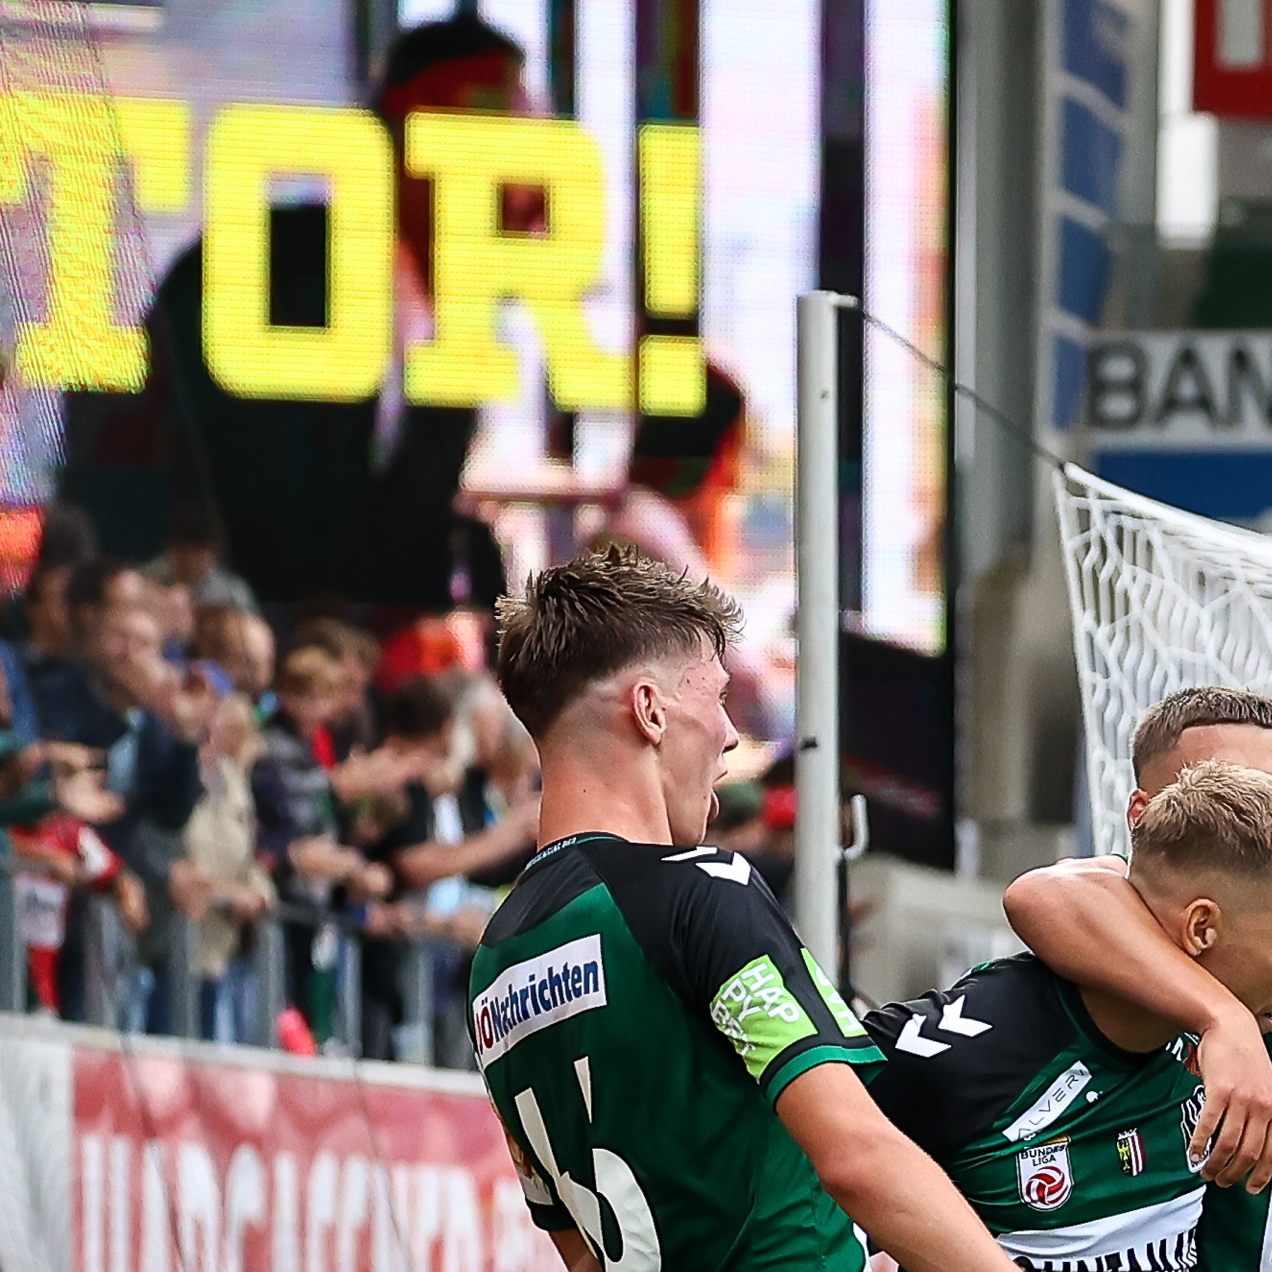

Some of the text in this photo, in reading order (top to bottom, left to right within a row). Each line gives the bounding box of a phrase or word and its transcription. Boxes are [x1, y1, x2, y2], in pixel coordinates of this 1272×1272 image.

[0, 88, 707, 418] TOR!
[475, 961, 601, 1056] ÖNachrichten
[721, 977, 764, 1024] PY
[740, 962, 801, 1024] HAP
[1020, 1143, 1067, 1160] BUNDES
[1031, 1154, 1057, 1168] LIGA
